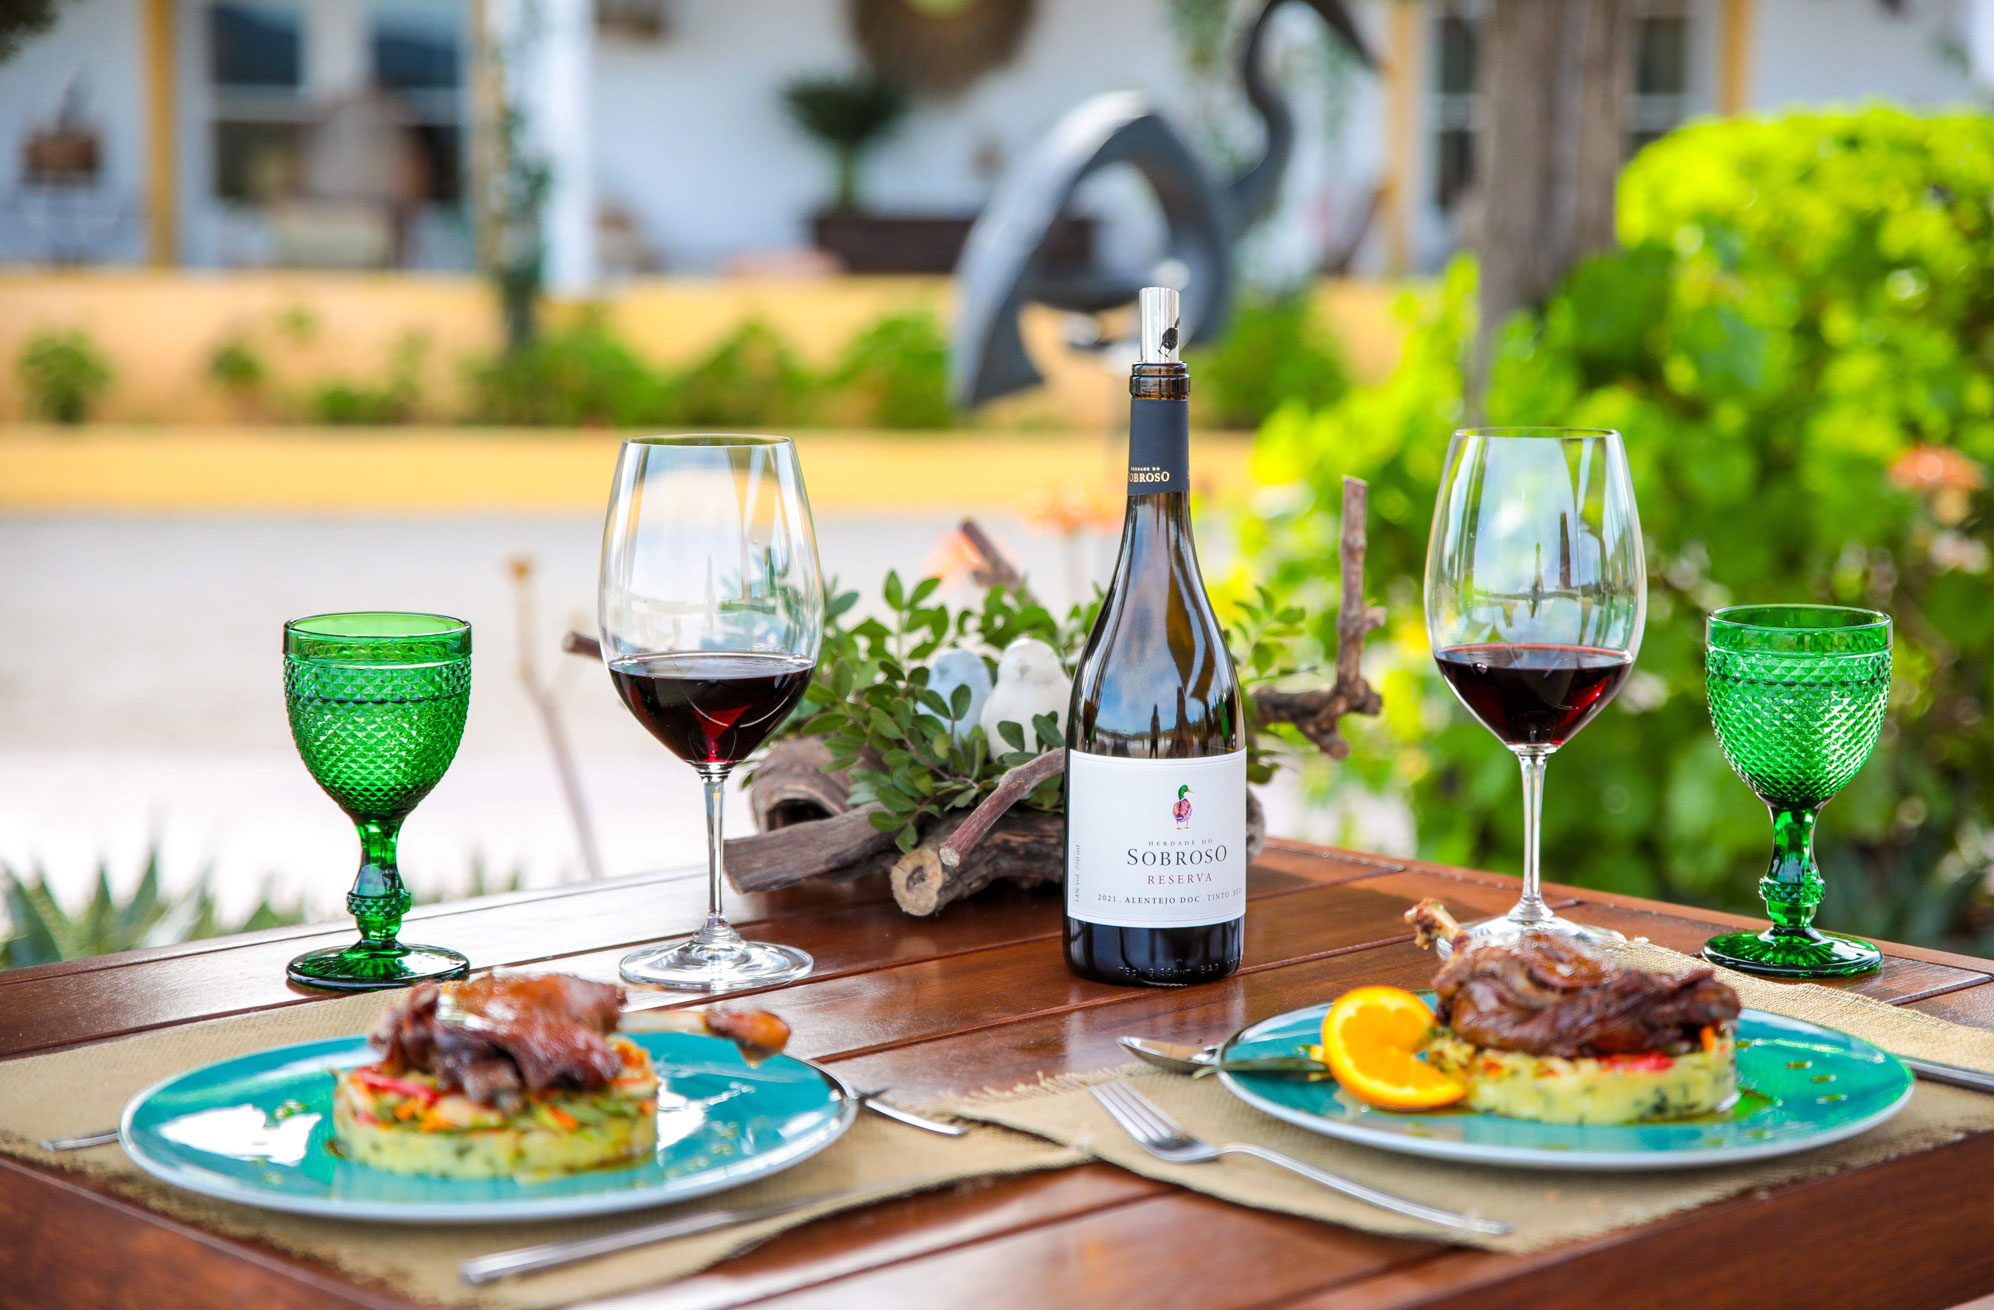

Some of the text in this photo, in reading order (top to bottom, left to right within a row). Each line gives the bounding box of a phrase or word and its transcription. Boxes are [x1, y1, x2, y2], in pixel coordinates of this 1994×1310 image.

[1127, 845, 1228, 867] SOBROSO
[1147, 872, 1213, 885] RESERVA
[1097, 894, 1117, 902] 2021
[1124, 896, 1176, 905] ALENTEJO
[1180, 895, 1200, 904] DOC
[1207, 891, 1230, 902] TINTO
